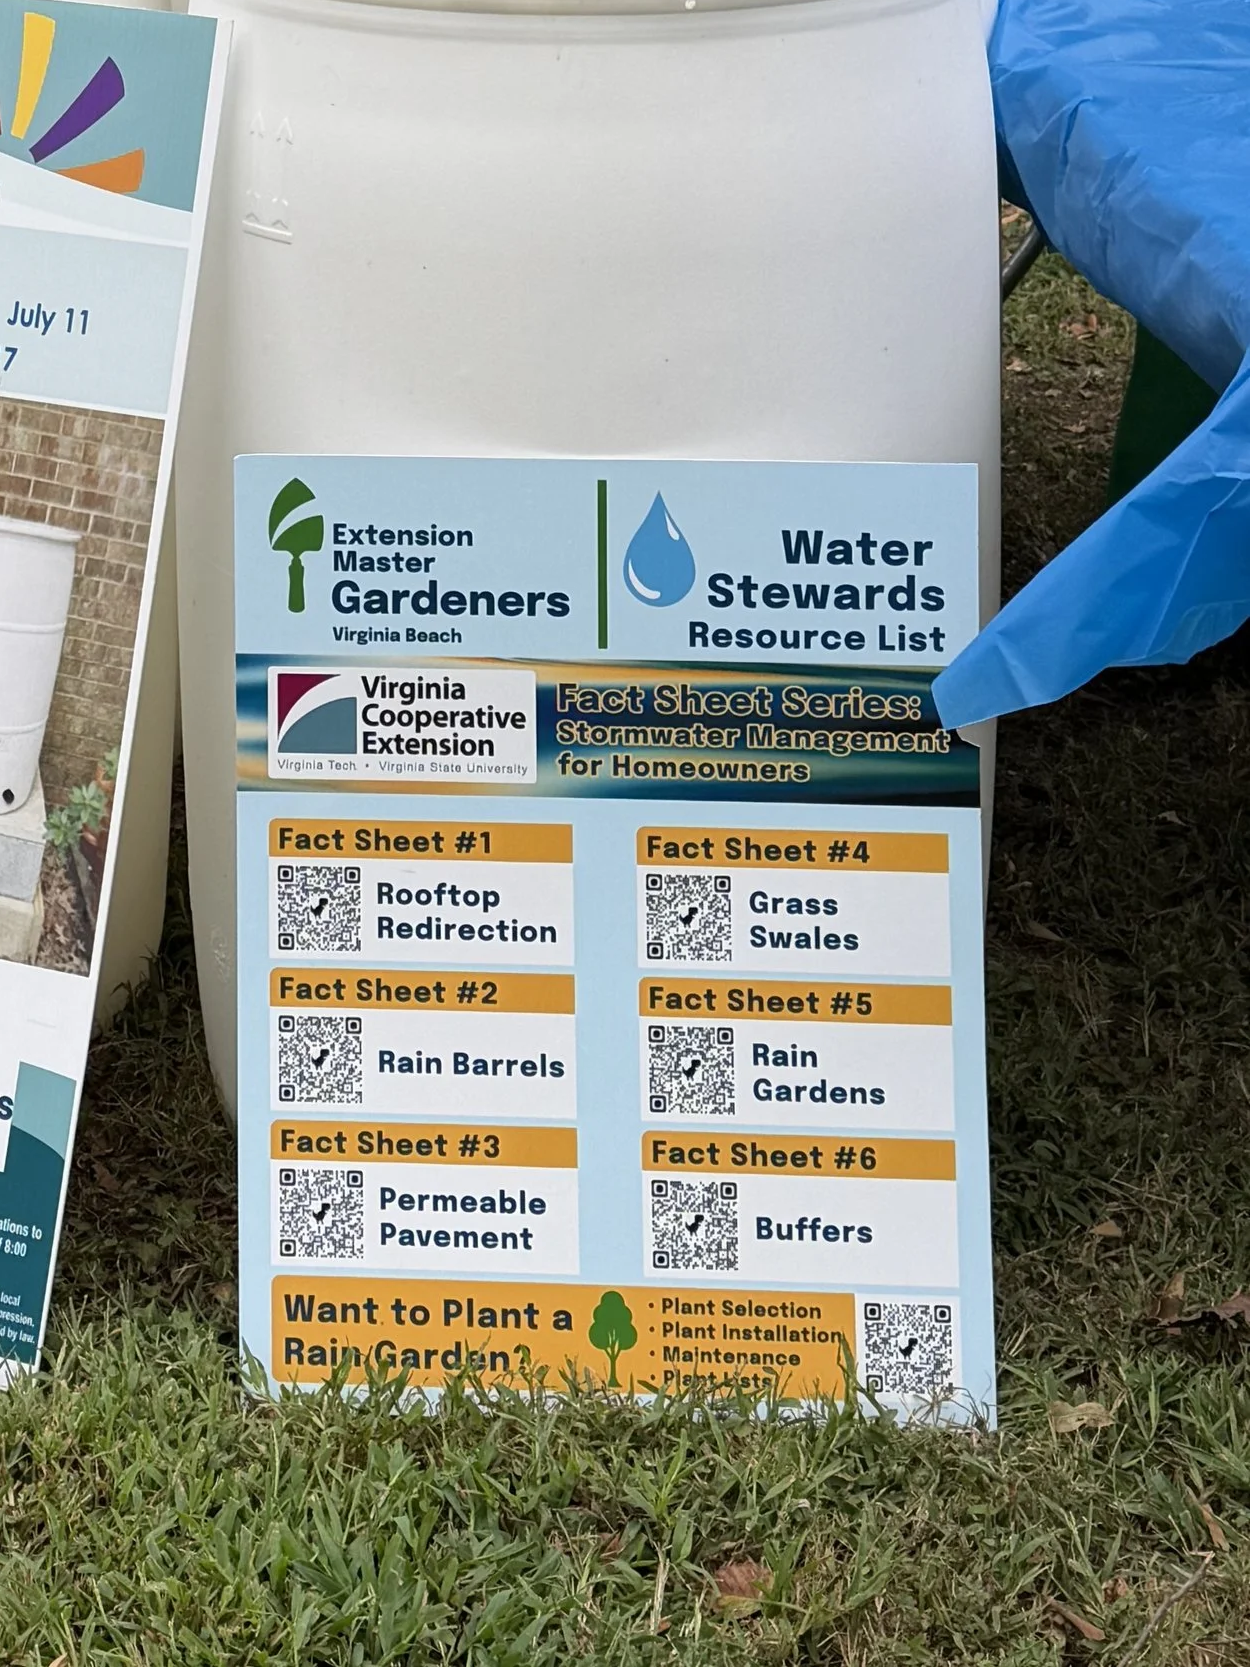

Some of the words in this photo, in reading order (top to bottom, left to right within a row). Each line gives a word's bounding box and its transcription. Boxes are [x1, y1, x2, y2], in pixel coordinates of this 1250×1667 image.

[6, 300, 57, 335] July
[65, 307, 89, 335] 11
[333, 523, 473, 547] Extension
[781, 529, 934, 567] Water
[333, 550, 436, 573] Master
[331, 579, 570, 618] Gardeners
[707, 572, 945, 612] Stewards
[332, 626, 401, 646] Virginia
[405, 627, 462, 644] Beach
[689, 621, 866, 651] Resource
[878, 624, 946, 653] List
[556, 683, 645, 715] Fact
[654, 684, 772, 718] Sheet
[781, 686, 922, 721] Series:
[556, 721, 740, 749] Stormwater
[748, 724, 951, 755] Management
[277, 759, 323, 773] Virginia
[328, 759, 357, 771] Tech
[378, 761, 425, 774] Virginia
[430, 761, 462, 773] State
[466, 763, 528, 777] University
[559, 753, 597, 775] for
[613, 755, 808, 783] Homeowners
[279, 827, 345, 851] Fact
[354, 828, 445, 853] Sheet
[454, 831, 490, 854] #1
[377, 882, 500, 913] Rooftop
[749, 890, 838, 916] Grass
[377, 916, 557, 943] Redirection
[750, 925, 859, 951] Swales
[378, 1050, 442, 1075] Rain
[453, 1052, 565, 1078] Barrels
[752, 1043, 818, 1068] Rain
[753, 1078, 886, 1105] Gardens
[380, 1186, 547, 1215] Permeable
[380, 1222, 534, 1251] Pavement
[756, 1216, 873, 1244] Buffers
[284, 1293, 384, 1325] Want
[390, 1298, 431, 1326] to
[443, 1297, 540, 1330] Plant
[552, 1309, 573, 1331] a
[661, 1297, 716, 1316] Plant
[721, 1299, 822, 1320] Selection
[662, 1321, 716, 1340] Plant
[722, 1323, 842, 1348] Installation
[284, 1337, 361, 1366] Rain
[663, 1345, 801, 1366] Maintenance
